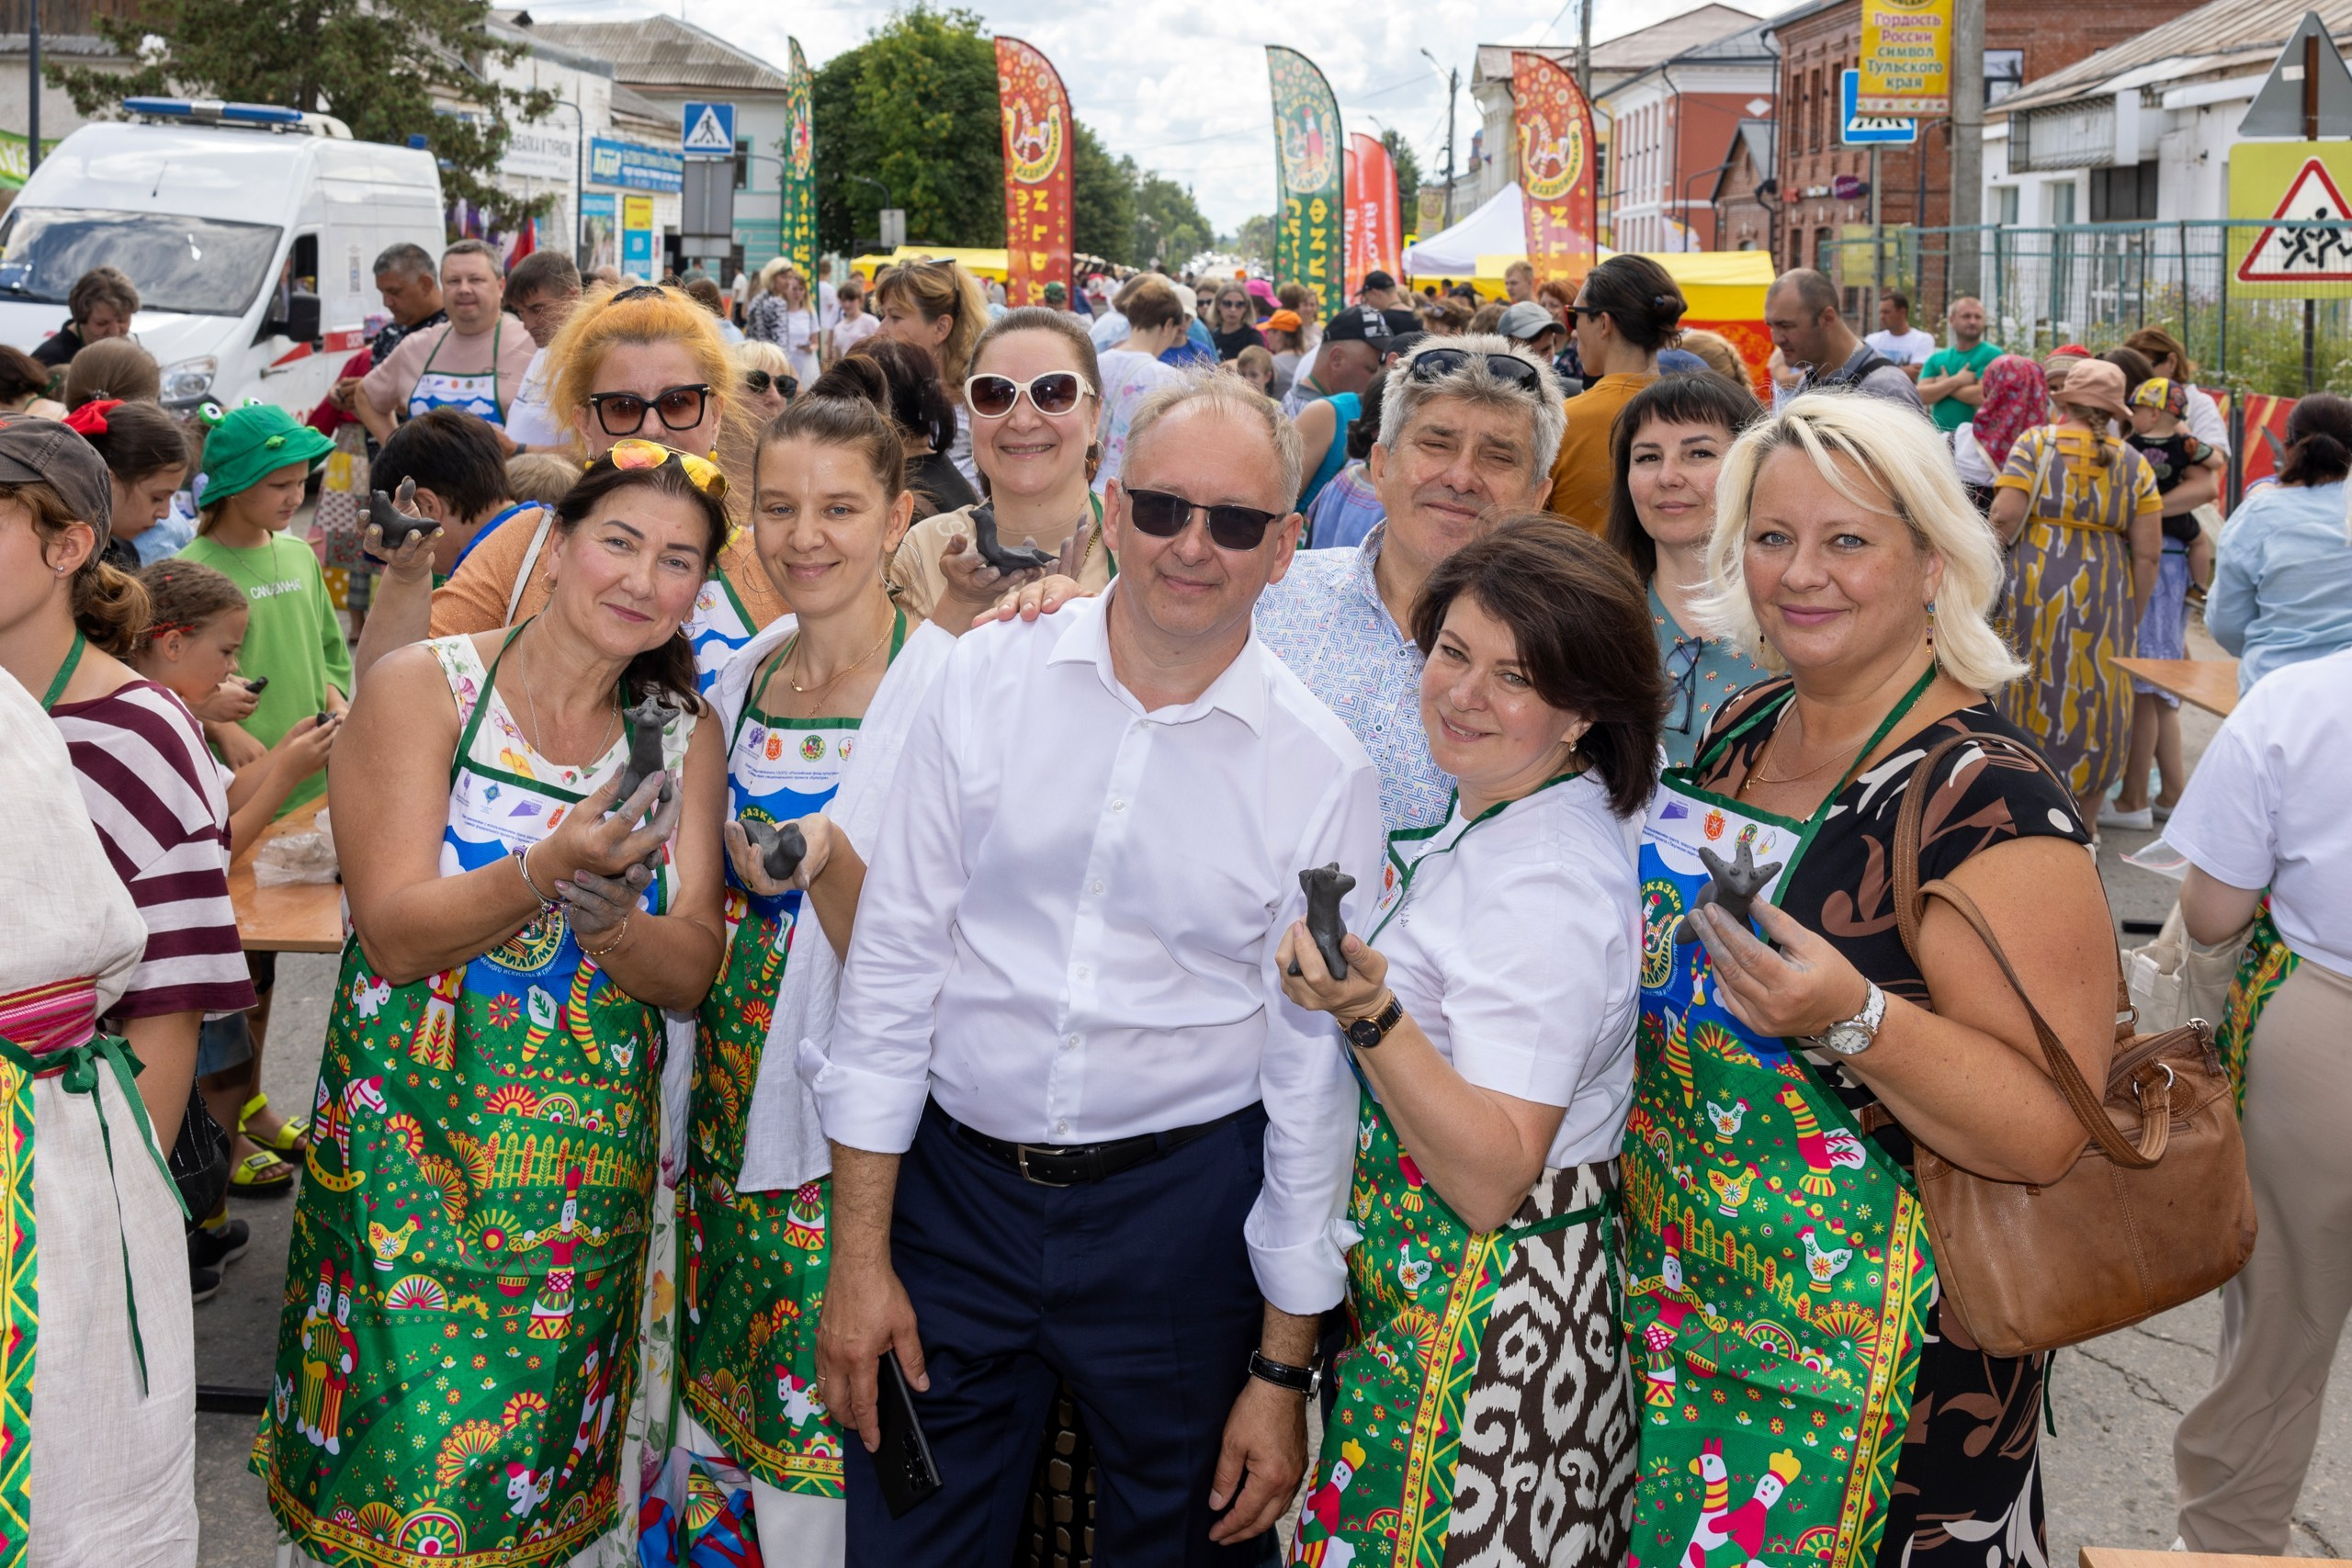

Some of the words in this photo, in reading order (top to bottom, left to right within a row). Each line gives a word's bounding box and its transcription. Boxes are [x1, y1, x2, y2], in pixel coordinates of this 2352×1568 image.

[1874, 13, 1941, 28] Гордость
[1882, 29, 1932, 42] России
[1878, 47, 1934, 57] символ
[1867, 59, 1943, 75] Тульского
[1885, 78, 1923, 90] края
[1642, 881, 1682, 911] СКАЗКИ
[480, 956, 503, 974] ЧАРНОГО
